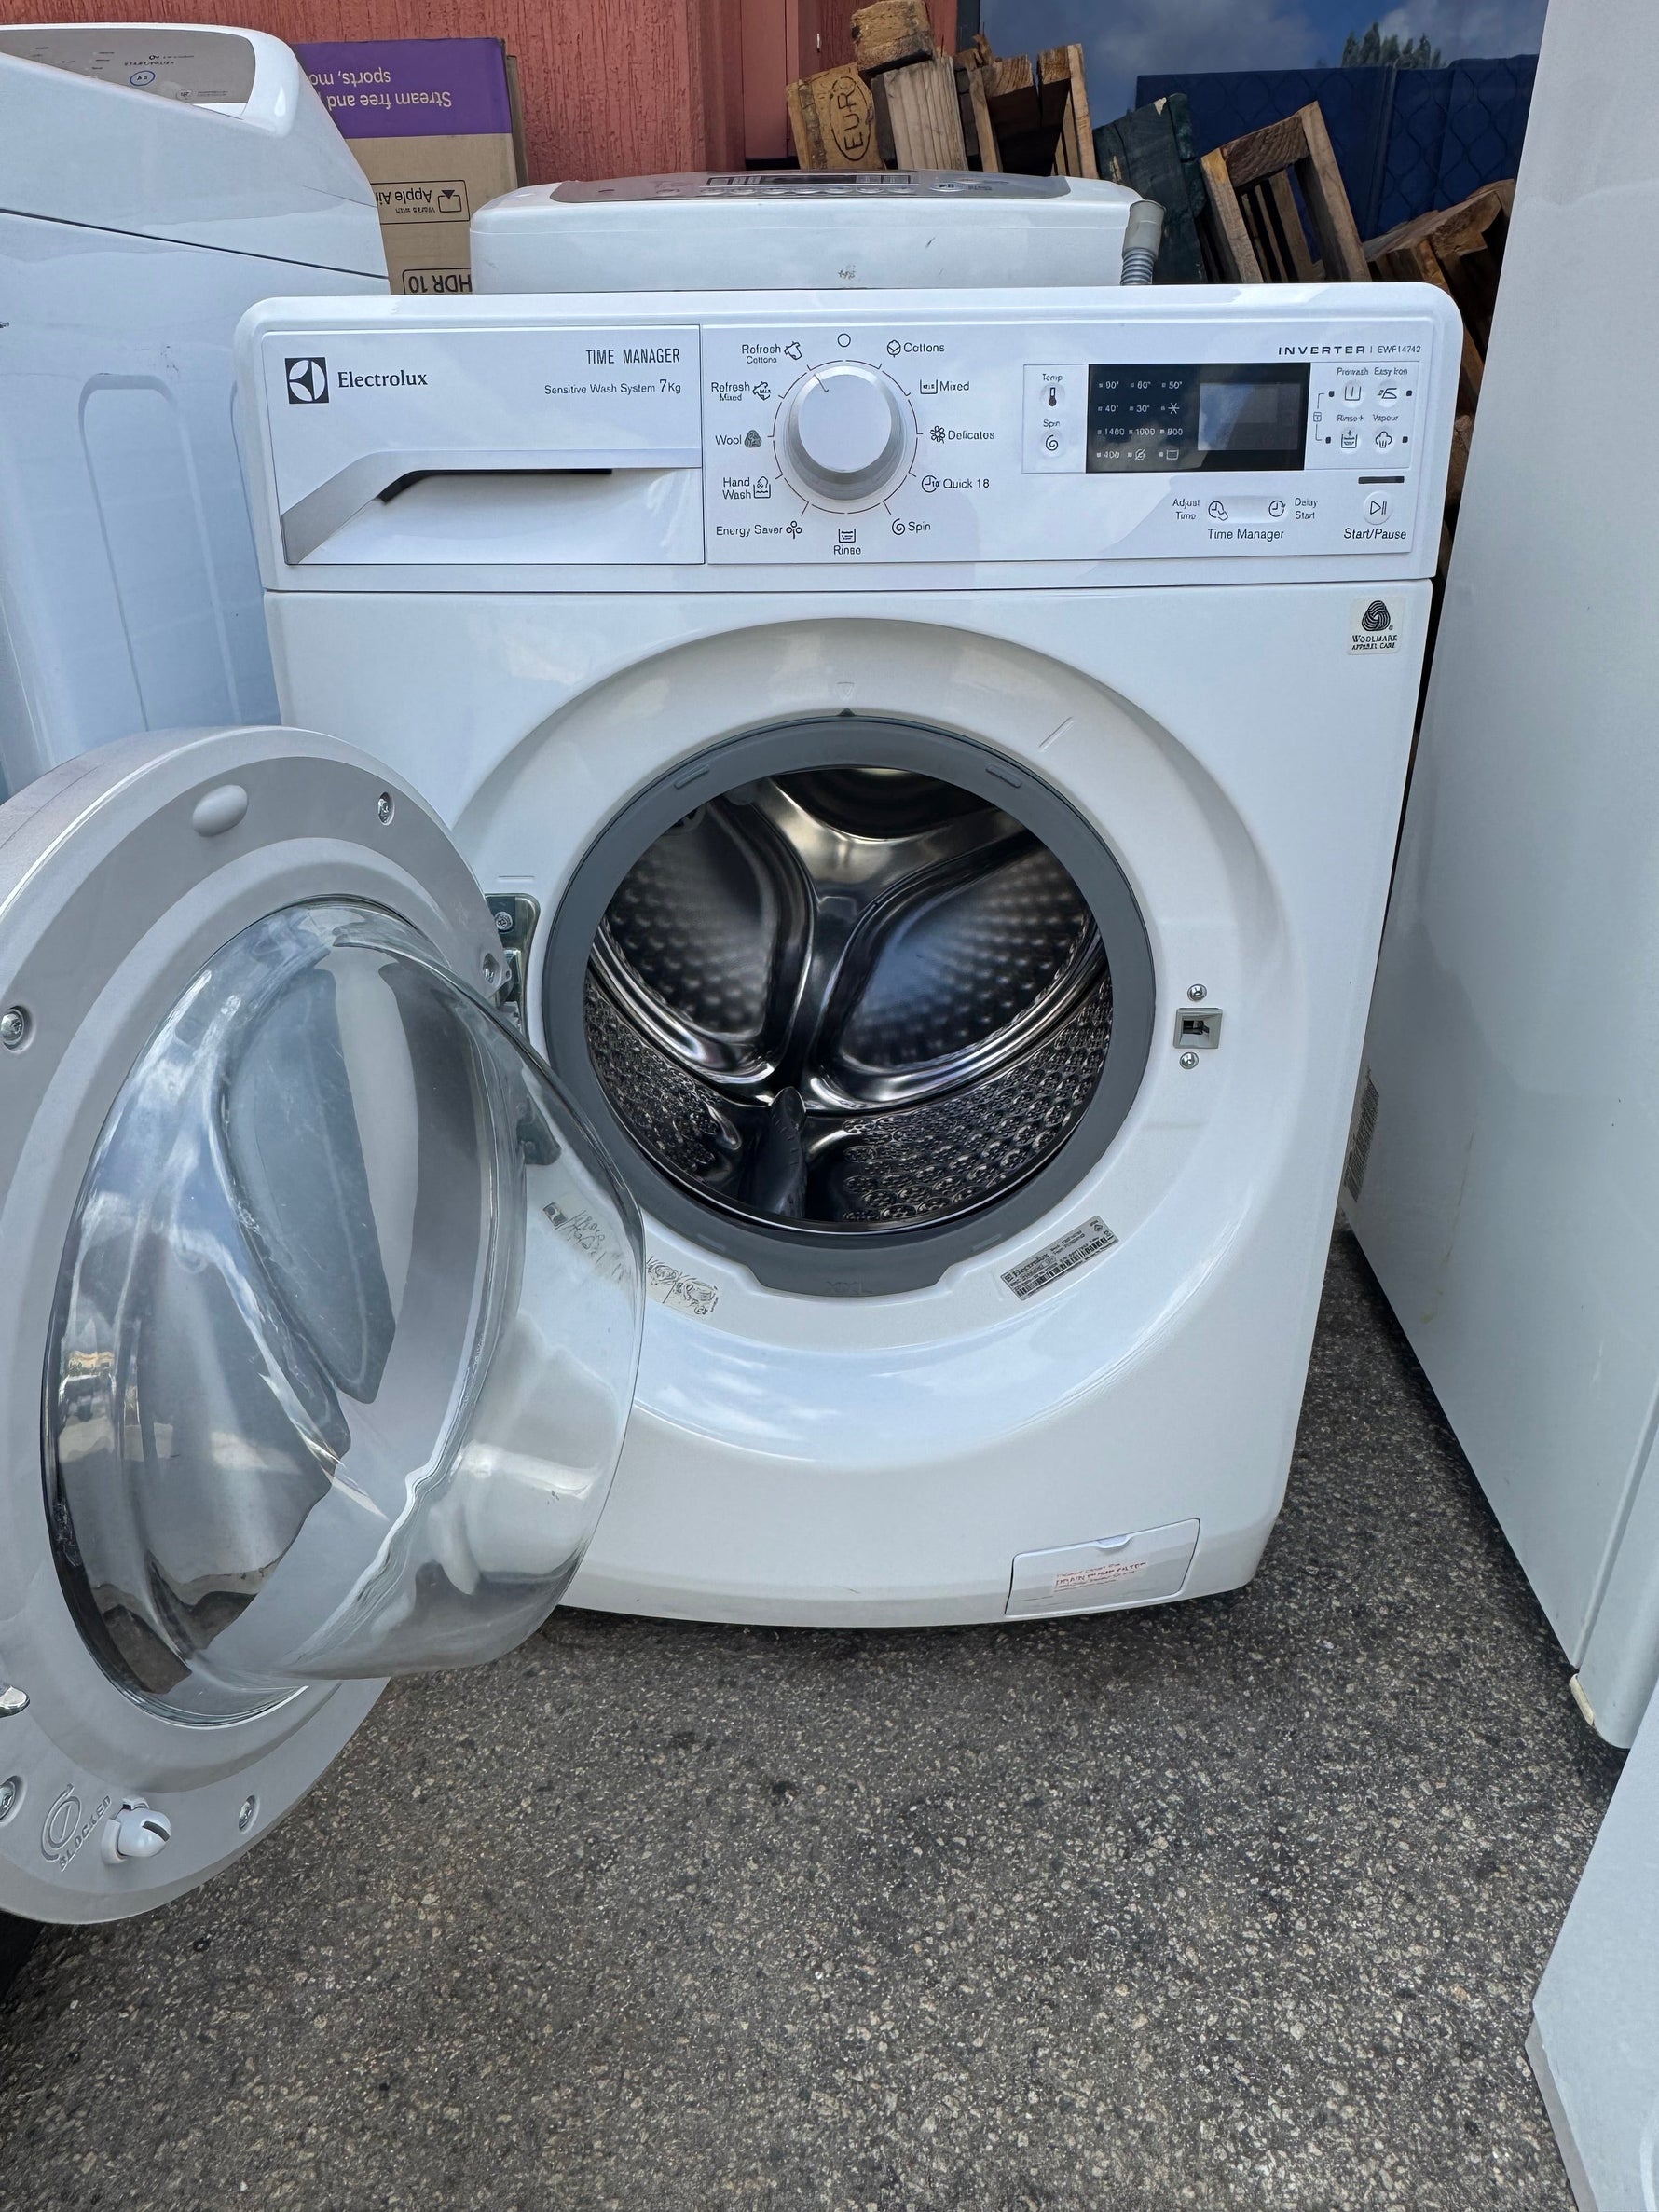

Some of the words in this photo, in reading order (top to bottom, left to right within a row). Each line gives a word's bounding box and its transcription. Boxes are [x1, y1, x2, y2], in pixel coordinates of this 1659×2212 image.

[338, 67, 391, 88] sports,
[327, 96, 356, 111] and
[360, 94, 391, 110] free
[396, 91, 452, 108] Stream
[395, 187, 432, 204] Apple
[407, 275, 428, 294] 10
[432, 274, 473, 294] HDR
[742, 343, 782, 354] Refresh
[903, 341, 946, 353] Cottons
[1278, 345, 1365, 355] INVERTER
[1378, 345, 1421, 354] EWF14742
[586, 349, 615, 364] TIME
[623, 348, 680, 364] MANAGER
[747, 355, 777, 364] Cottons
[1336, 367, 1369, 377] Prewash
[1374, 366, 1392, 377] Easy
[1393, 366, 1408, 376] Iron
[337, 370, 429, 389] Electrolux
[1042, 373, 1063, 382] Temp
[544, 384, 587, 395] Sensitive
[590, 383, 617, 394] Wash
[620, 382, 656, 396] System
[711, 381, 750, 392] Refresh
[939, 380, 970, 392] Mixed
[720, 392, 743, 401] Mixed
[1043, 419, 1061, 428] Spin
[1373, 414, 1399, 423] Vapour
[947, 430, 995, 440] Delicates
[1104, 428, 1125, 436] 1400
[1135, 428, 1156, 436] 1000
[1167, 428, 1184, 436] 800
[715, 434, 742, 446] Wool
[1104, 450, 1120, 459] 400
[722, 476, 750, 488] Hand
[942, 478, 973, 489] Quick
[977, 478, 990, 488] 18
[722, 489, 752, 500] Wash
[1172, 498, 1200, 509] Adjust
[1294, 497, 1319, 508] Delay
[1175, 511, 1197, 520] Time
[1295, 510, 1316, 520] Start
[716, 525, 751, 538] Energy
[754, 524, 783, 535] Saver
[908, 521, 931, 534] Spin
[1208, 528, 1234, 540] Time
[1237, 528, 1284, 543] Manager
[1343, 528, 1407, 541] Start/Pause
[833, 544, 861, 556] Rinse
[1351, 634, 1398, 643] WOOLMARK
